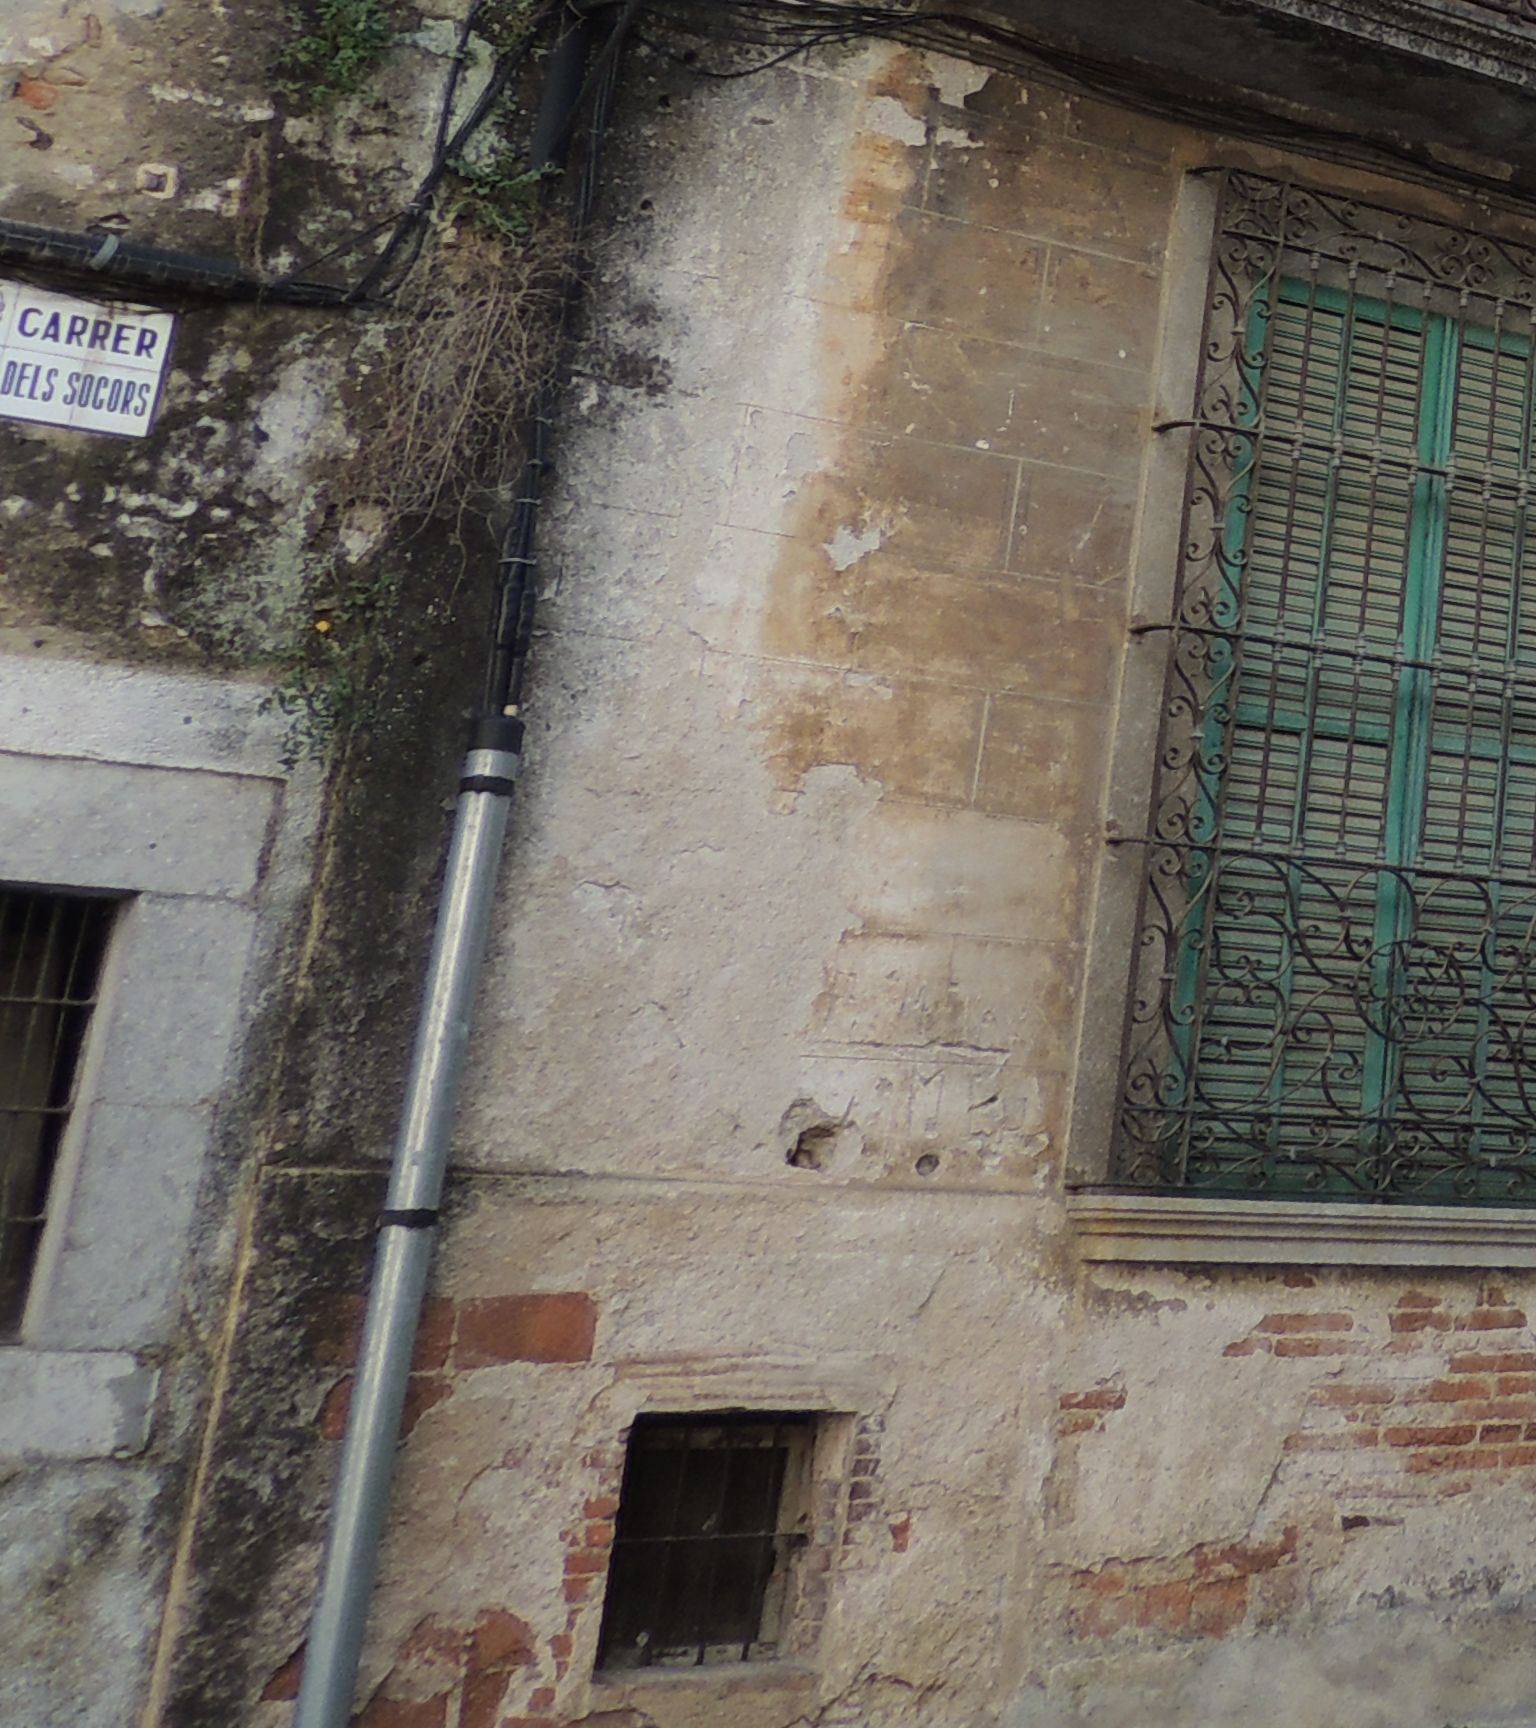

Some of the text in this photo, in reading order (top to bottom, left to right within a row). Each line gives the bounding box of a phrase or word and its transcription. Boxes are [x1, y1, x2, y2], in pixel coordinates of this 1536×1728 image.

[17, 307, 159, 359] CARRER
[1, 360, 151, 417] DELS SOCORS
